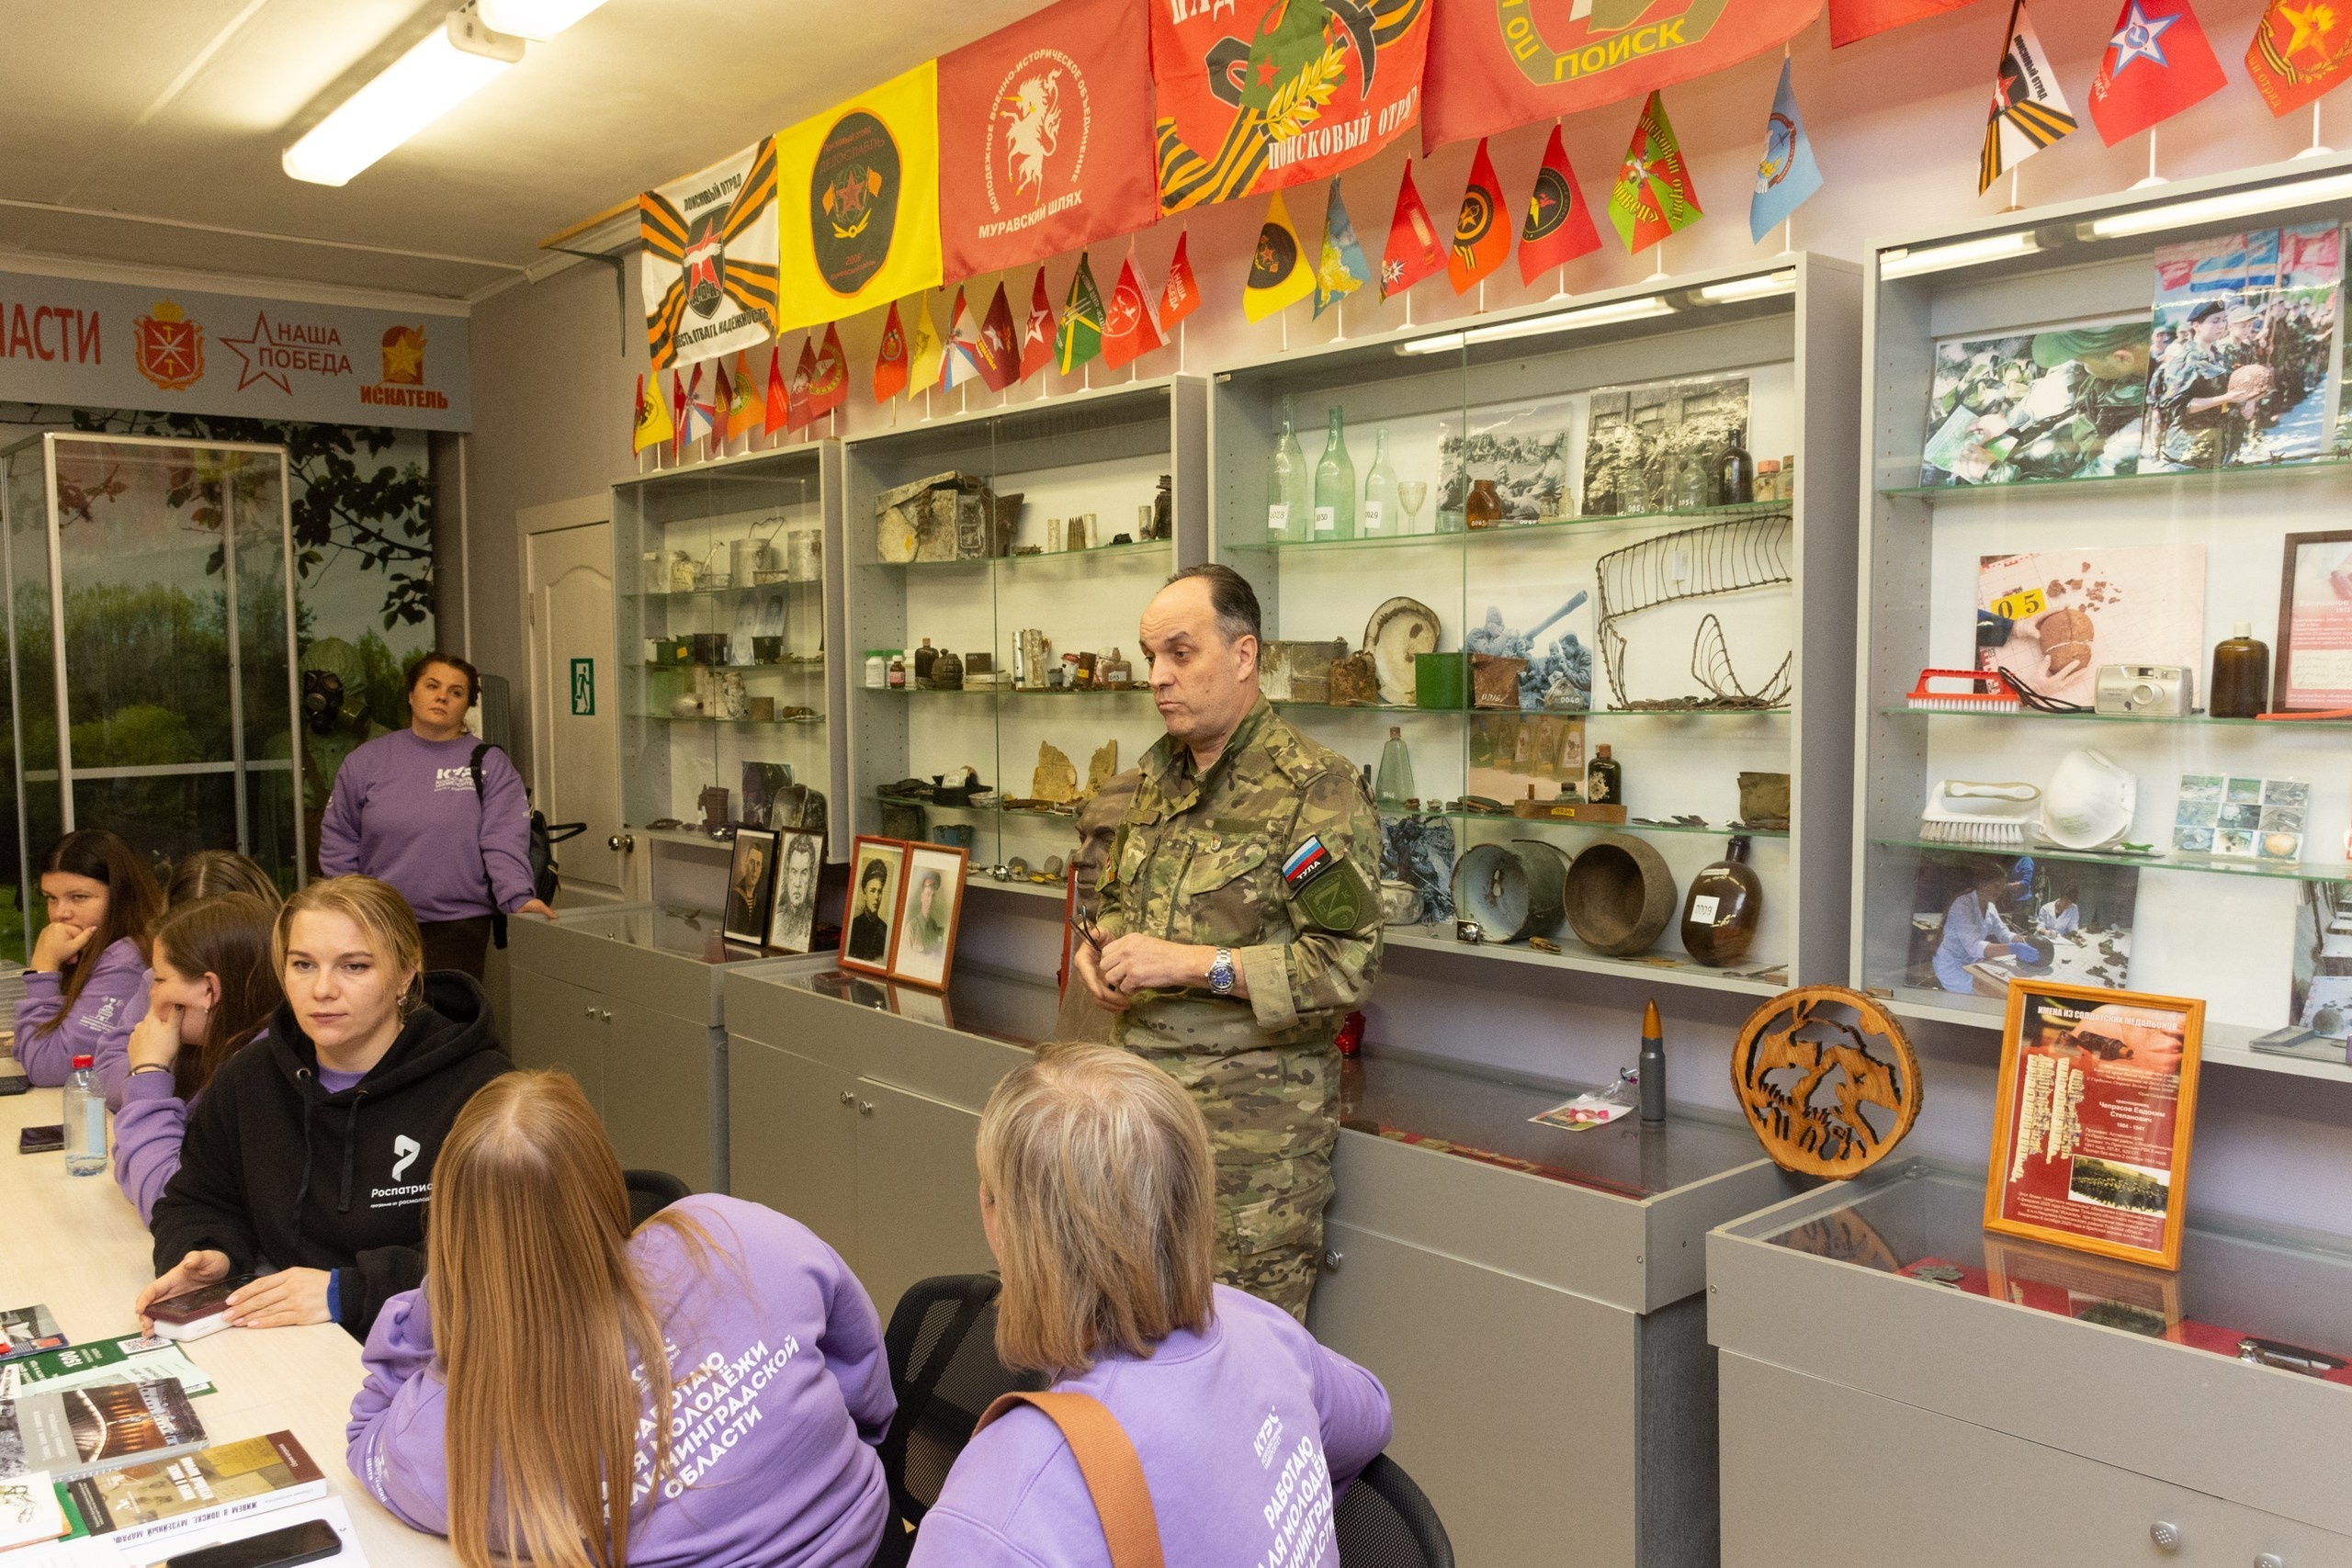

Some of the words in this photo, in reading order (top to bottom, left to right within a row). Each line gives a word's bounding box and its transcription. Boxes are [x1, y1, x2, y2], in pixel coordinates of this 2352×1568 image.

[1554, 17, 1686, 82] ПОИСК
[2014, 34, 2038, 81] ПОИСКОВЫЙ
[2030, 71, 2049, 102] ОТРЯД
[1070, 80, 1091, 183] ОБЪЕДИНЕНИЕ
[1268, 109, 1371, 171] ПОИСКОВЫЙ
[684, 183, 720, 212] ПОИСКОВЫЙ
[720, 173, 741, 192] ОТРЯД
[978, 204, 1046, 239] МУРАВСКИЙ
[1047, 189, 1083, 216] ШЛЯХ
[1166, 278, 1179, 312] ОБЕДА
[1173, 273, 1187, 301] НАША
[277, 322, 342, 346] НАША
[259, 346, 353, 376] ПОБЕДА
[360, 385, 448, 410] ИСКАТЕЛЬ
[1997, 600, 2013, 619] 0
[2024, 593, 2040, 614] 5
[1296, 861, 1321, 880] ТУЛА
[2038, 1006, 2064, 1018] ИМЕНА
[2064, 1009, 2074, 1019] ИЗ
[2075, 1010, 2123, 1025] СОЛДАТСКИХ
[2124, 1016, 2177, 1031] МЕДАЛЬОНОВ
[371, 1183, 433, 1198] Роспатрио
[398, 1197, 431, 1207] росмолод
[58, 1350, 83, 1368] 1500
[664, 1404, 763, 1499] ОБЛАСТИ
[1263, 1436, 1313, 1530] РАБОТАЮ
[232, 1500, 258, 1515] ЖИВЕМ
[113, 1528, 144, 1544] МАРАФ
[147, 1517, 188, 1535] МУЗЕЙНЫЙ
